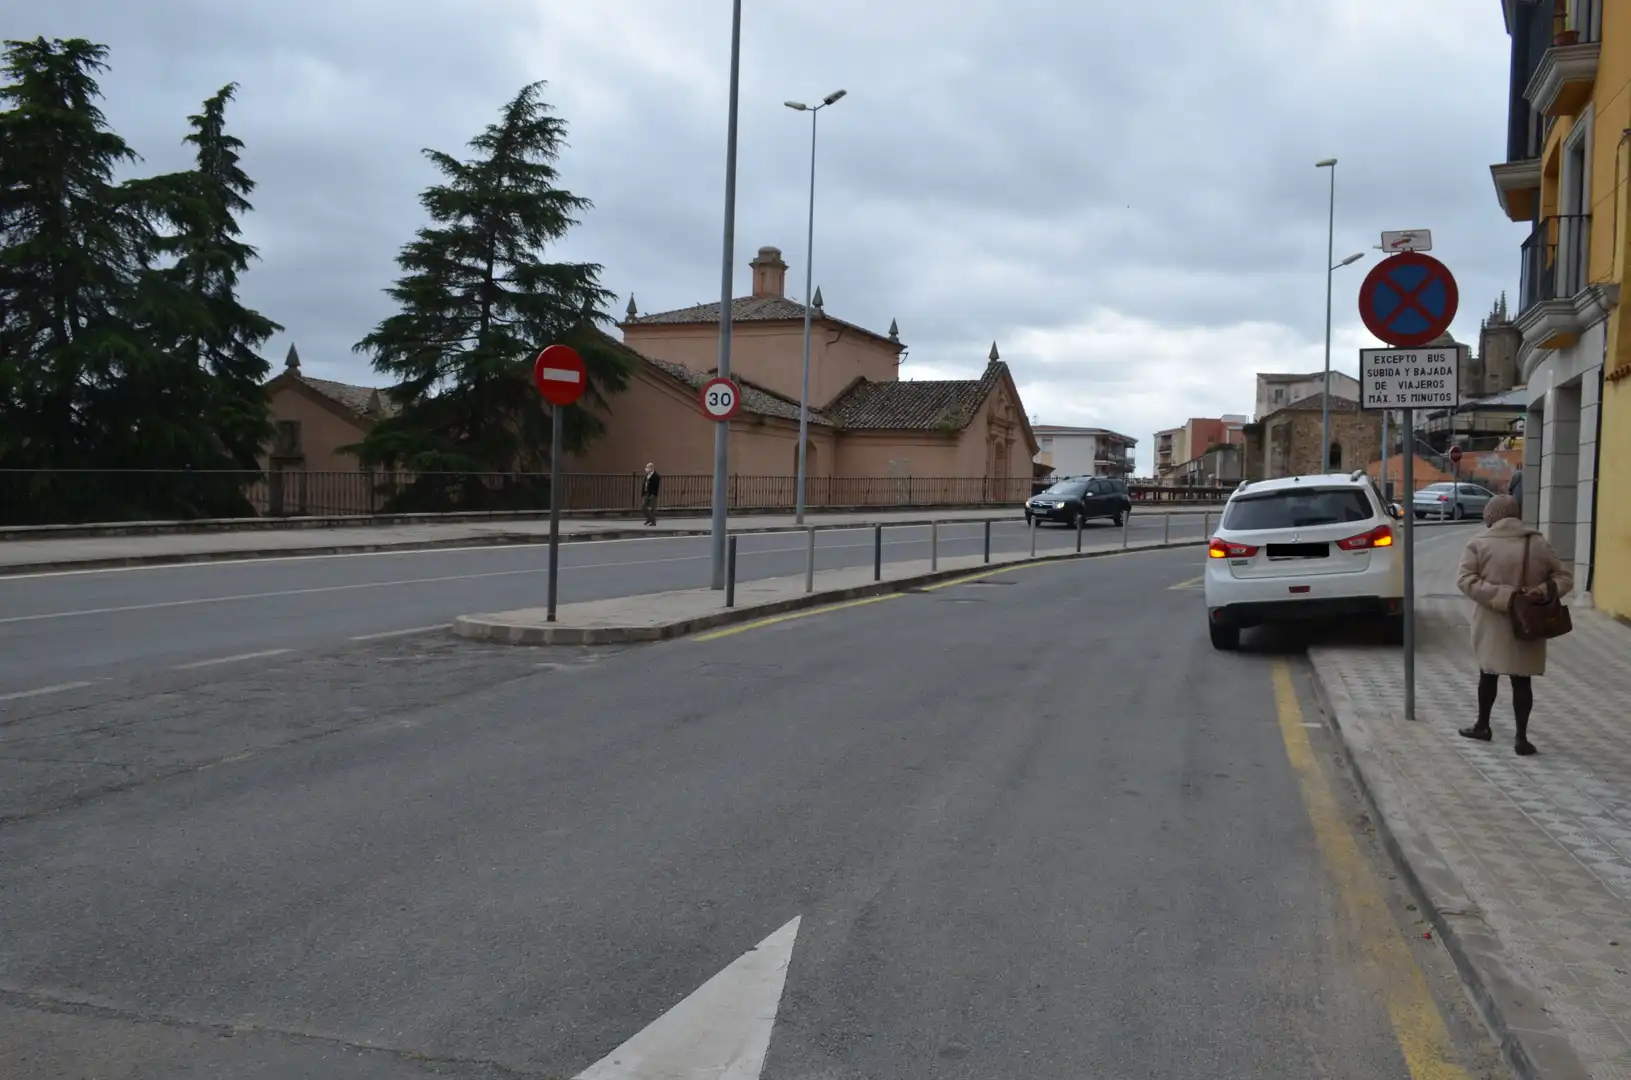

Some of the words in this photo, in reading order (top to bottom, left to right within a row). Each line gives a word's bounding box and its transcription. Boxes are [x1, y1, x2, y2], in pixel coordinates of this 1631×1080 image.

[1374, 354, 1417, 365] EXCEPTO
[1427, 353, 1446, 363] BUS
[1367, 367, 1401, 378] SUBIDA
[1404, 367, 1411, 377] Y
[1413, 366, 1453, 377] BAJADA
[1374, 381, 1387, 390] DE
[1398, 380, 1445, 390] VIAJEROS
[709, 392, 731, 407] 30
[1396, 393, 1407, 403] 15
[1410, 392, 1452, 403] MINUTOS
